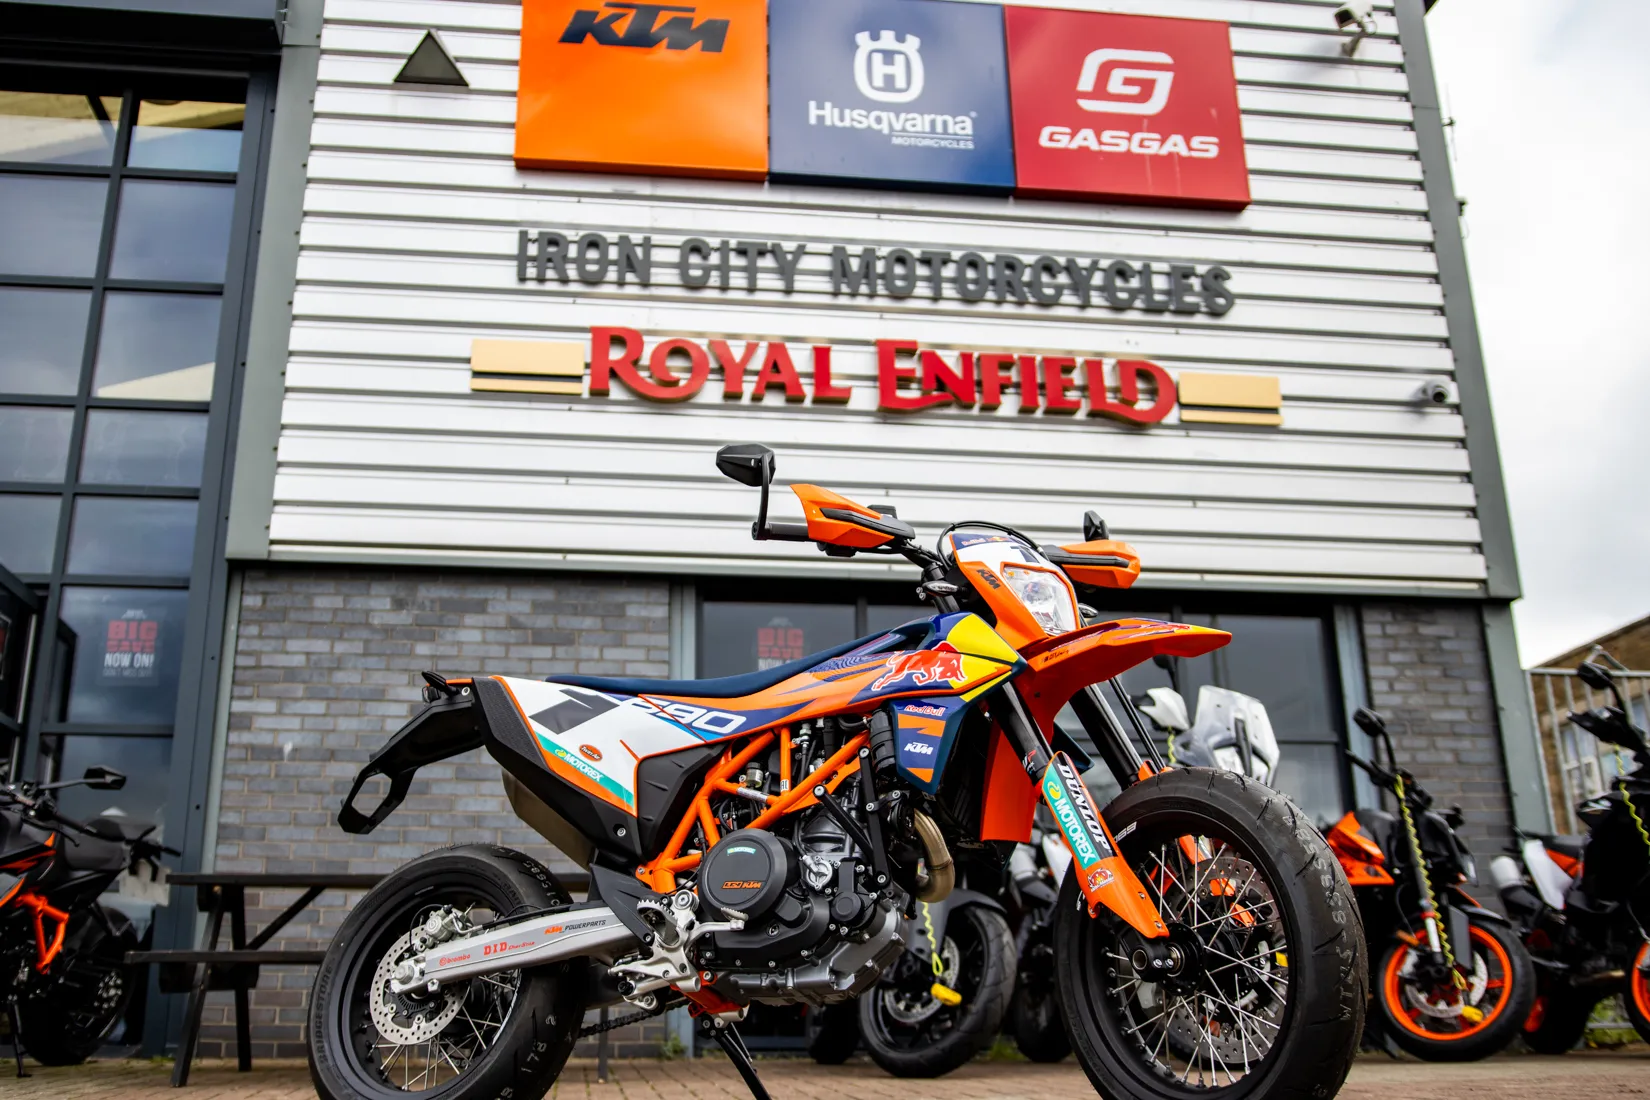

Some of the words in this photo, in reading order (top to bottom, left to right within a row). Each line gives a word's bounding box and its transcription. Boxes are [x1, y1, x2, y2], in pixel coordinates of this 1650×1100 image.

[558, 2, 730, 52] KTM
[891, 136, 975, 150] MOTORCYCLES
[1038, 125, 1219, 159] GASGAS
[517, 230, 652, 287] IRON
[678, 237, 807, 294] CITY
[831, 245, 1236, 317] MOTORCYCLES
[588, 325, 852, 403] ROYAL
[876, 338, 1178, 427] ENFIELD
[976, 568, 1001, 590] KTM
[107, 620, 158, 640] BIG
[104, 652, 132, 668] NOW
[133, 652, 155, 668] ON!
[903, 742, 934, 755] KTM
[564, 753, 605, 782] MOTOREX
[1057, 763, 1110, 850] DUNLOP
[1054, 797, 1096, 864] MOTOREX
